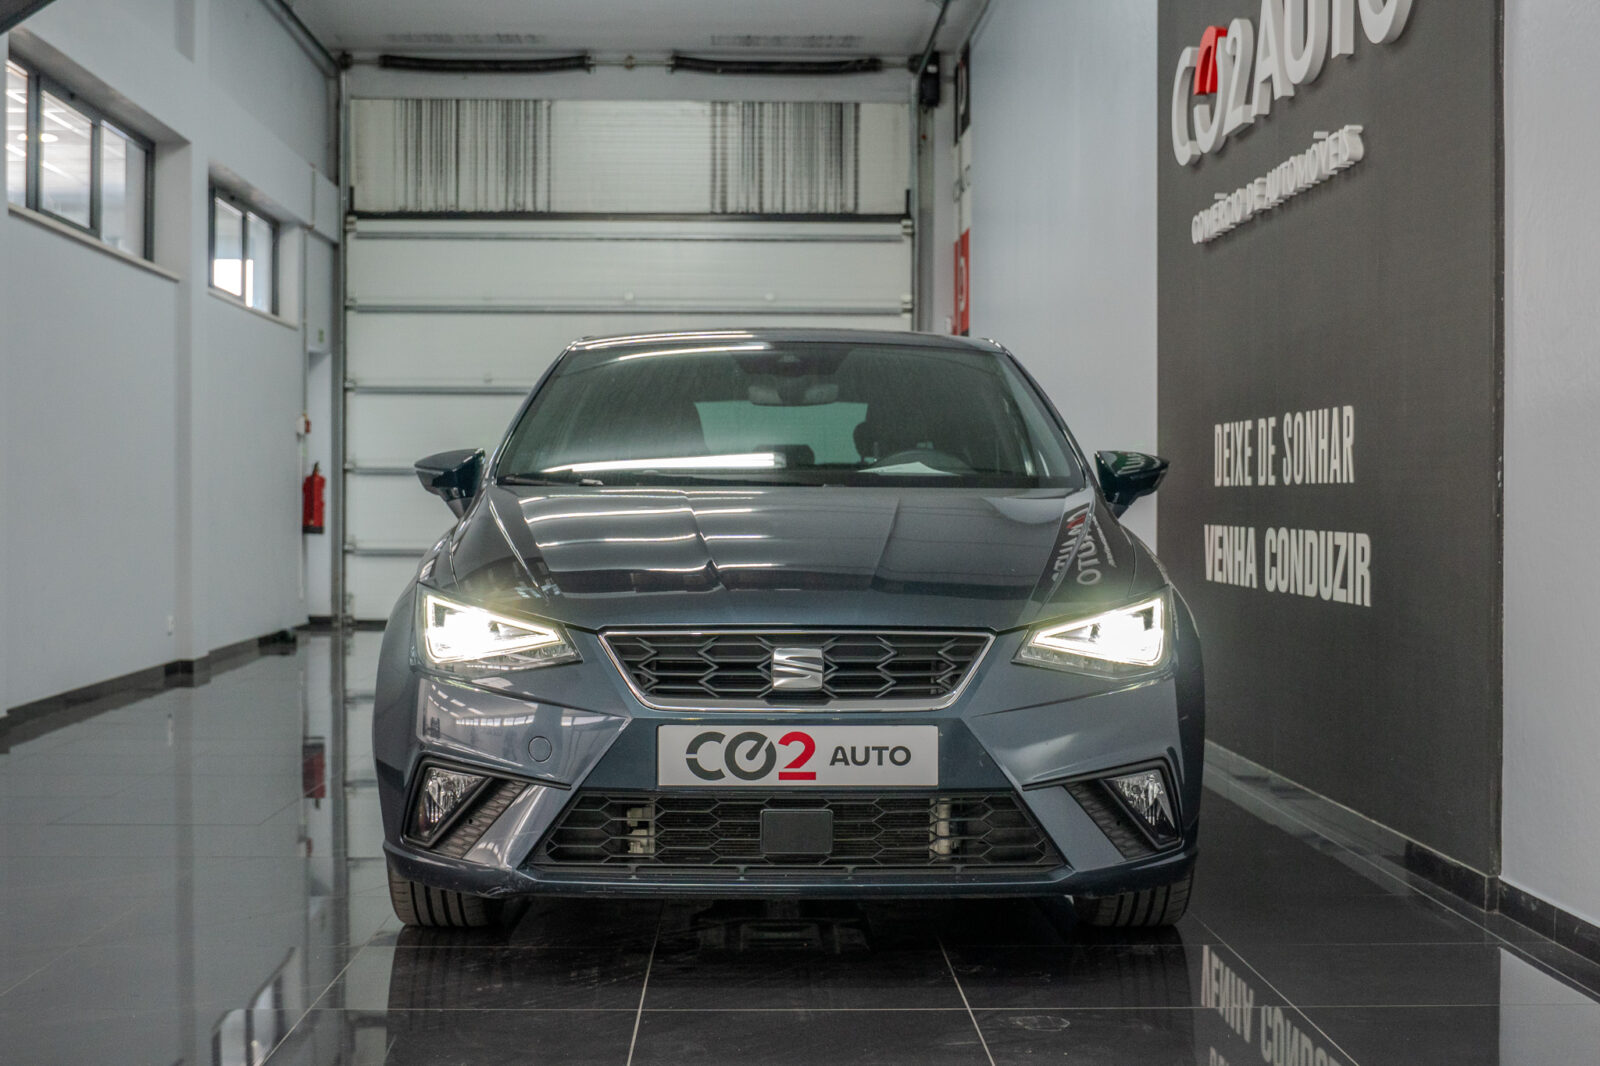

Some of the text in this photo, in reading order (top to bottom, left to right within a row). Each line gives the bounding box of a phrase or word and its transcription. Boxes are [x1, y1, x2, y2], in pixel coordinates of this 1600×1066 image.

[1214, 405, 1355, 487] DEIXE DE SONHAR
[1204, 524, 1258, 589] VENHA
[1264, 527, 1372, 608] CONDUZIR
[685, 731, 912, 781] CO2 AUTO
